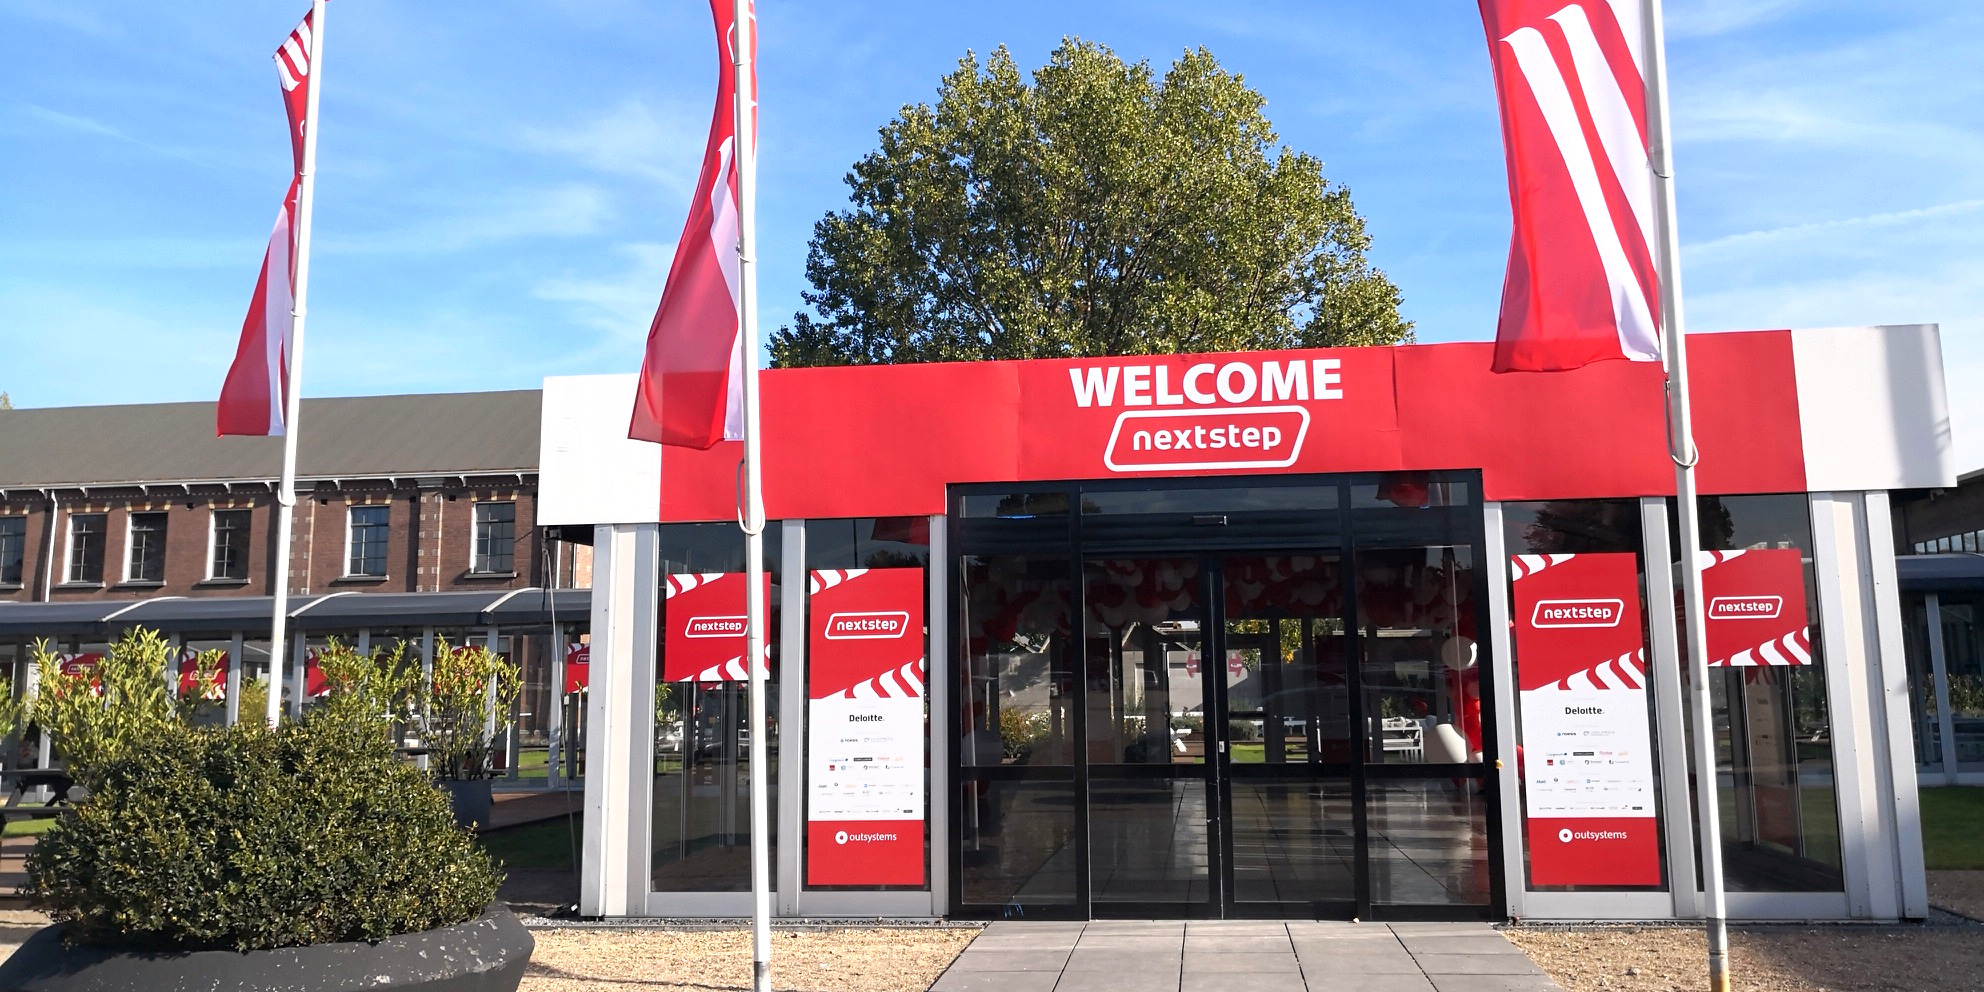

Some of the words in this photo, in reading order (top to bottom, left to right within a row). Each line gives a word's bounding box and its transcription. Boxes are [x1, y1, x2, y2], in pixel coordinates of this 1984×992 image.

[1069, 359, 1343, 408] WELCOME
[1132, 423, 1282, 451] nextstep
[1544, 605, 1612, 620] nextstep
[1718, 600, 1774, 613] nextstep
[694, 620, 742, 633] nextstep
[836, 618, 898, 632] nextstep
[849, 831, 897, 843] outsystems
[1574, 829, 1628, 842] outsystems
